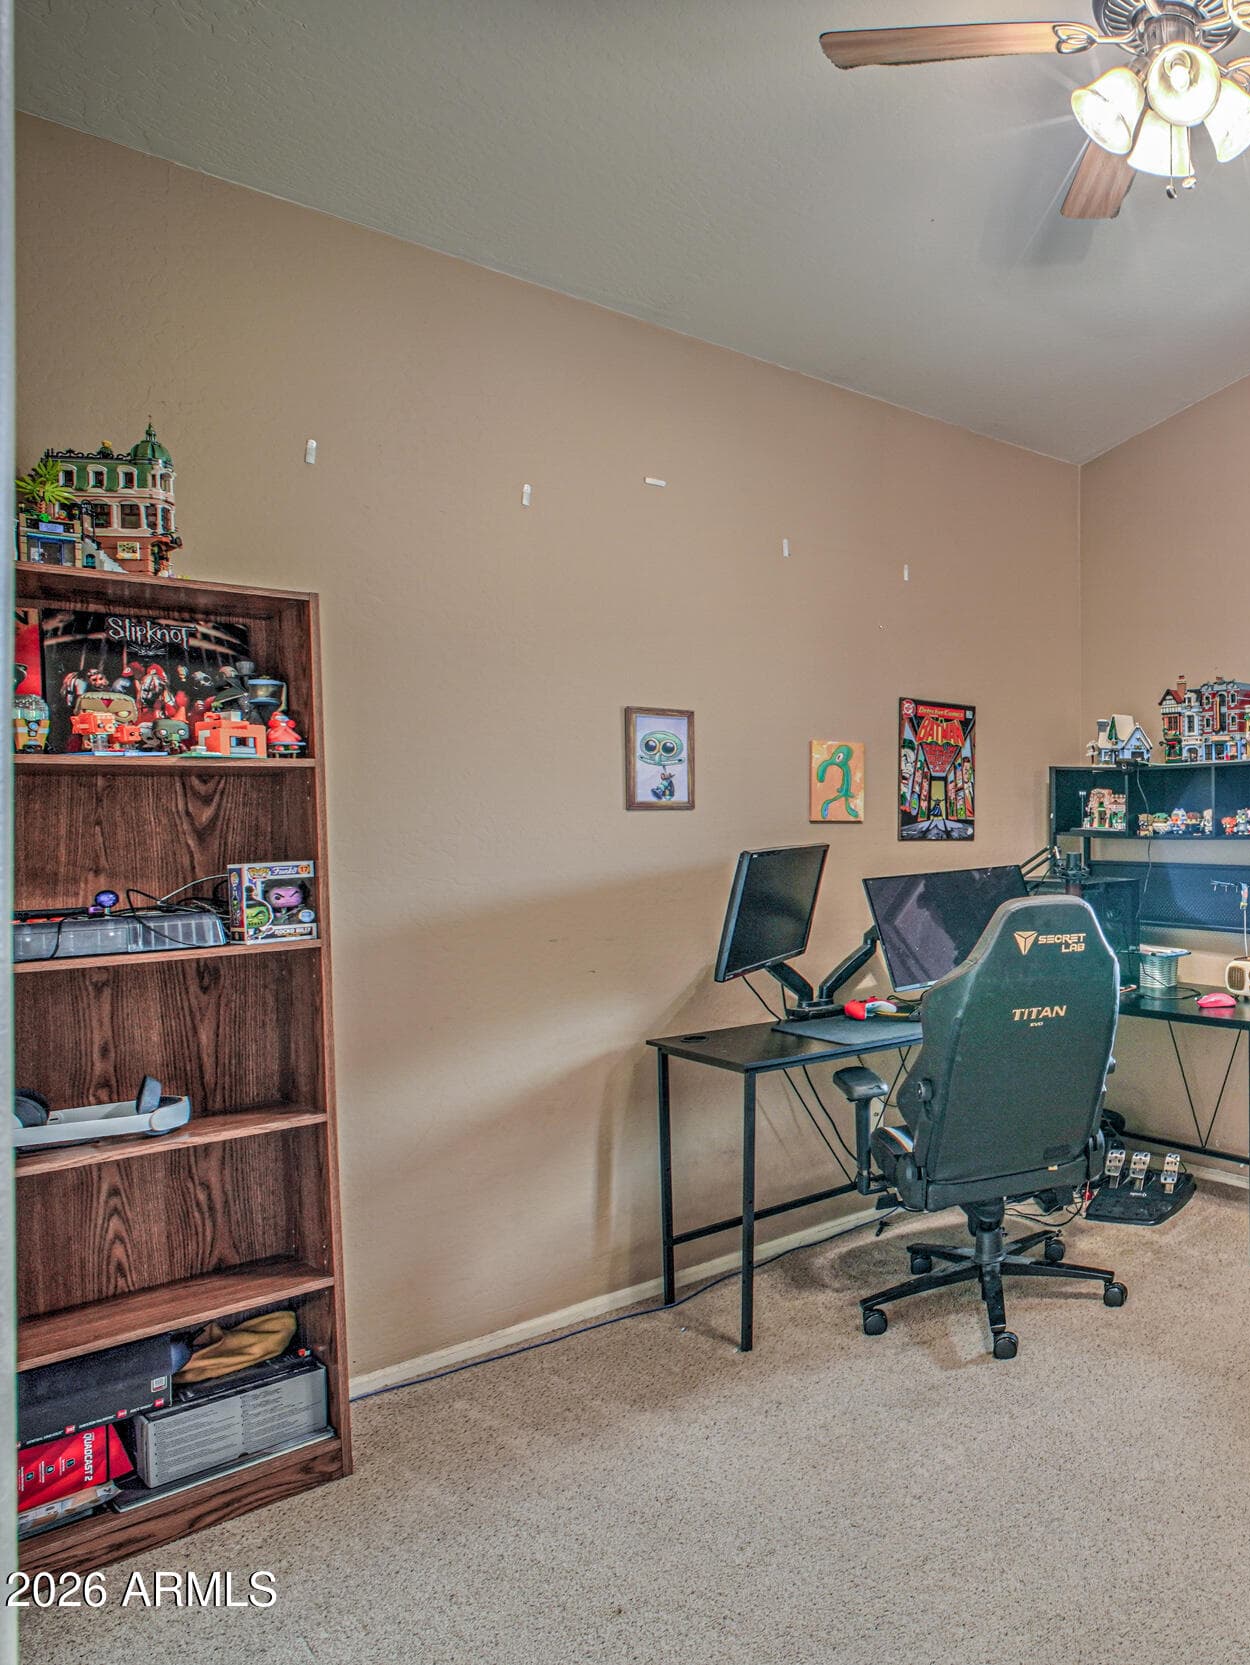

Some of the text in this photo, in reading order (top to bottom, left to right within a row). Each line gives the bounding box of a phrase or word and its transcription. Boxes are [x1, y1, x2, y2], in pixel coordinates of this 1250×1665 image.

[1037, 933, 1087, 945] SECRET
[1061, 943, 1086, 953] LAB
[1012, 1005, 1067, 1021] TITAN
[82, 1432, 95, 1483] QUADCAST 2
